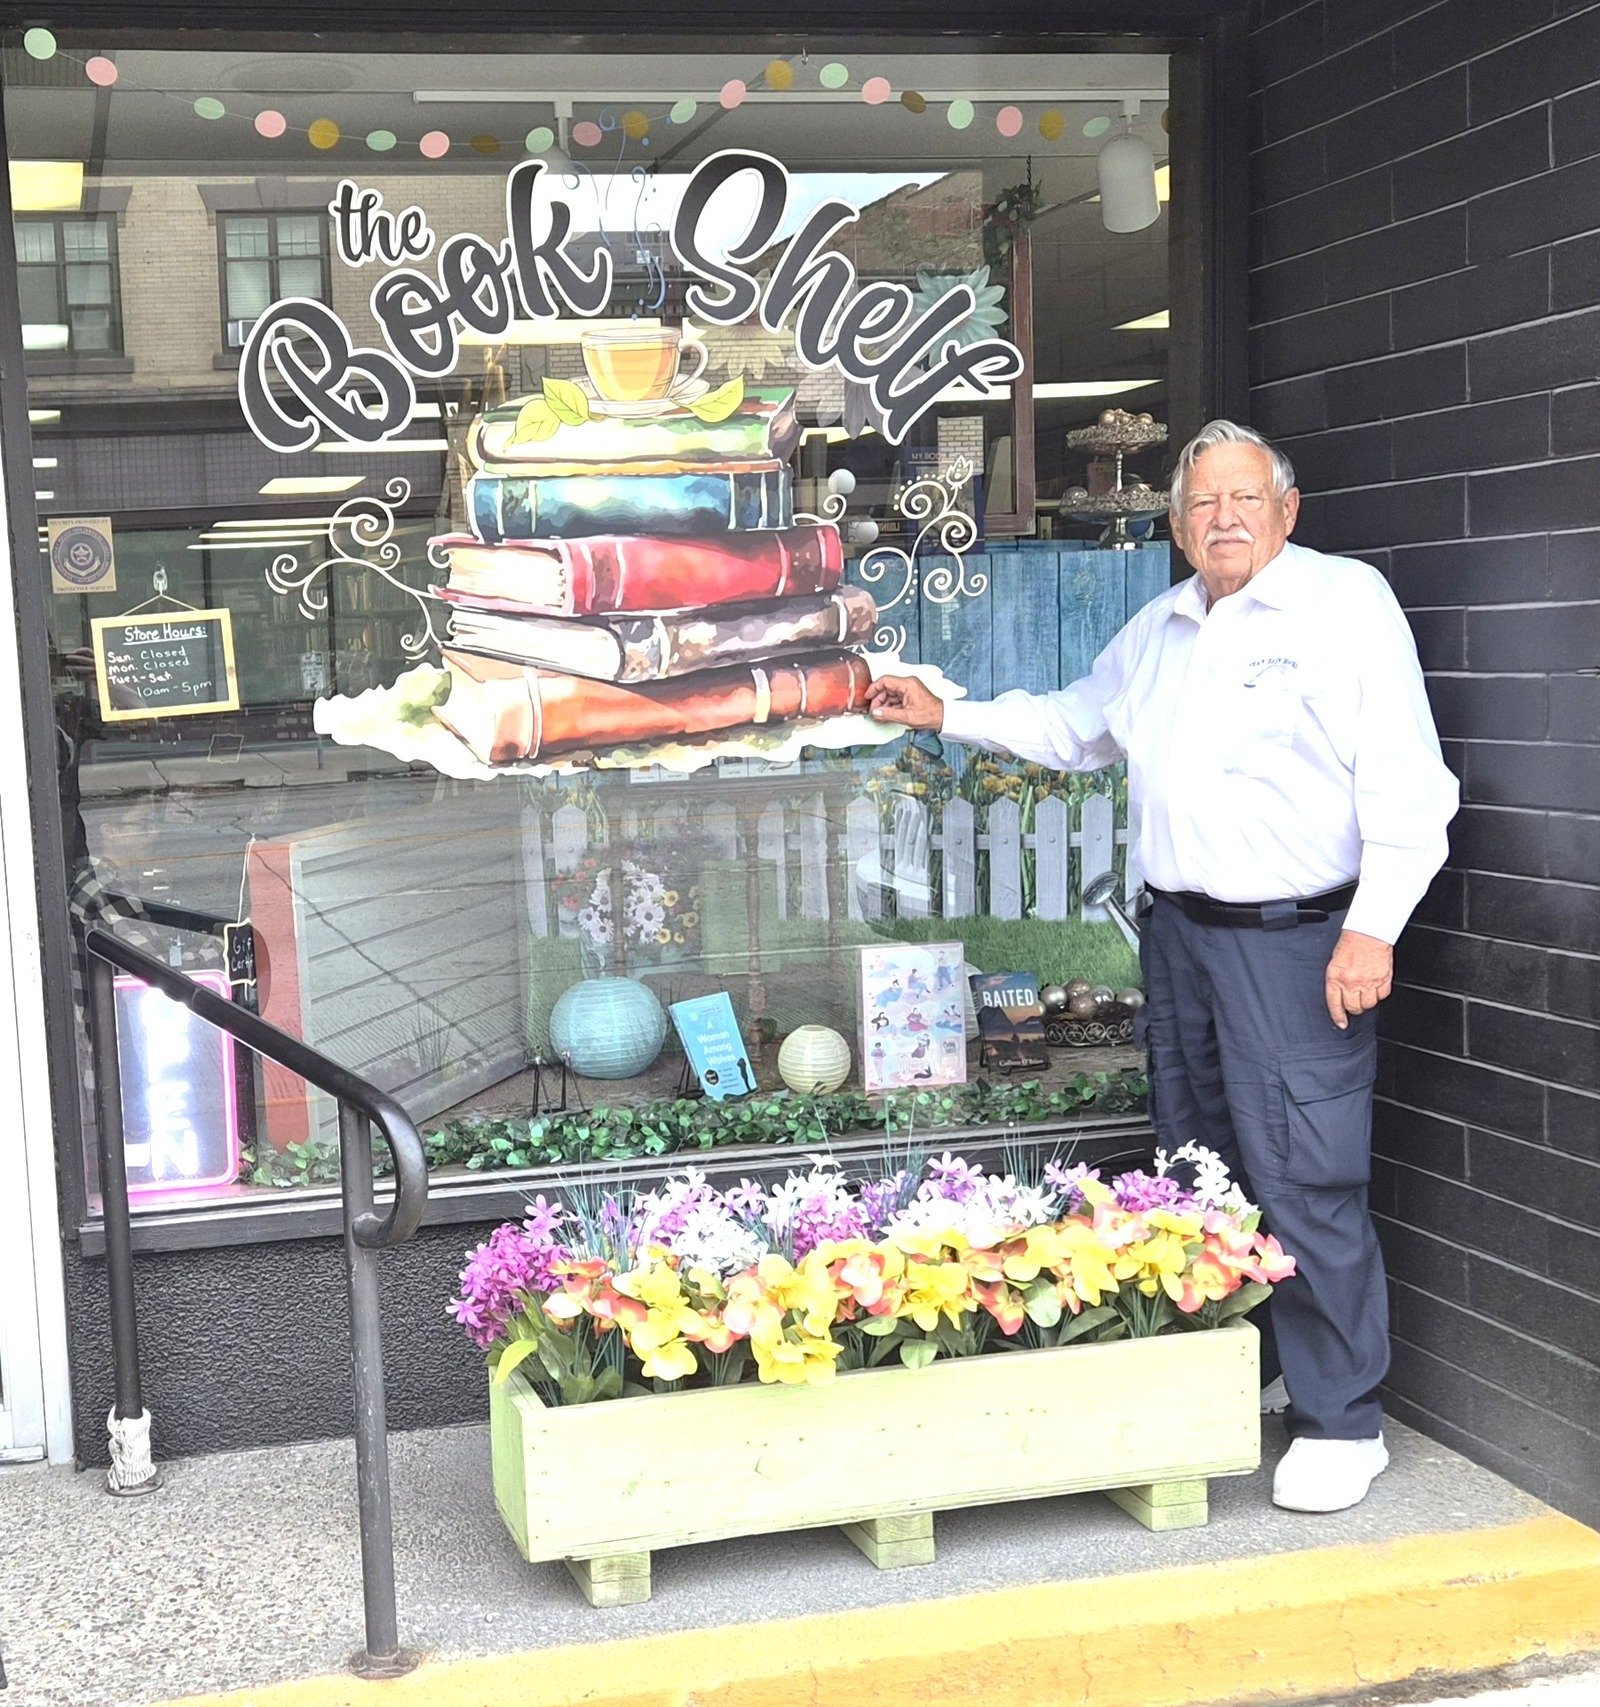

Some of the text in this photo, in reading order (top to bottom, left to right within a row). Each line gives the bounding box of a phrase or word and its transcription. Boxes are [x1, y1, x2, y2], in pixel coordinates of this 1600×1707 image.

[331, 179, 433, 267] the
[239, 149, 1024, 453] Book Shelf
[124, 623, 206, 642] Store Hours:
[107, 646, 186, 664] Sun. Closed
[108, 657, 190, 676] Mon. Closed
[982, 989, 1034, 1008] BAITED
[696, 1031, 730, 1044] Woman
[704, 1043, 733, 1056] Among
